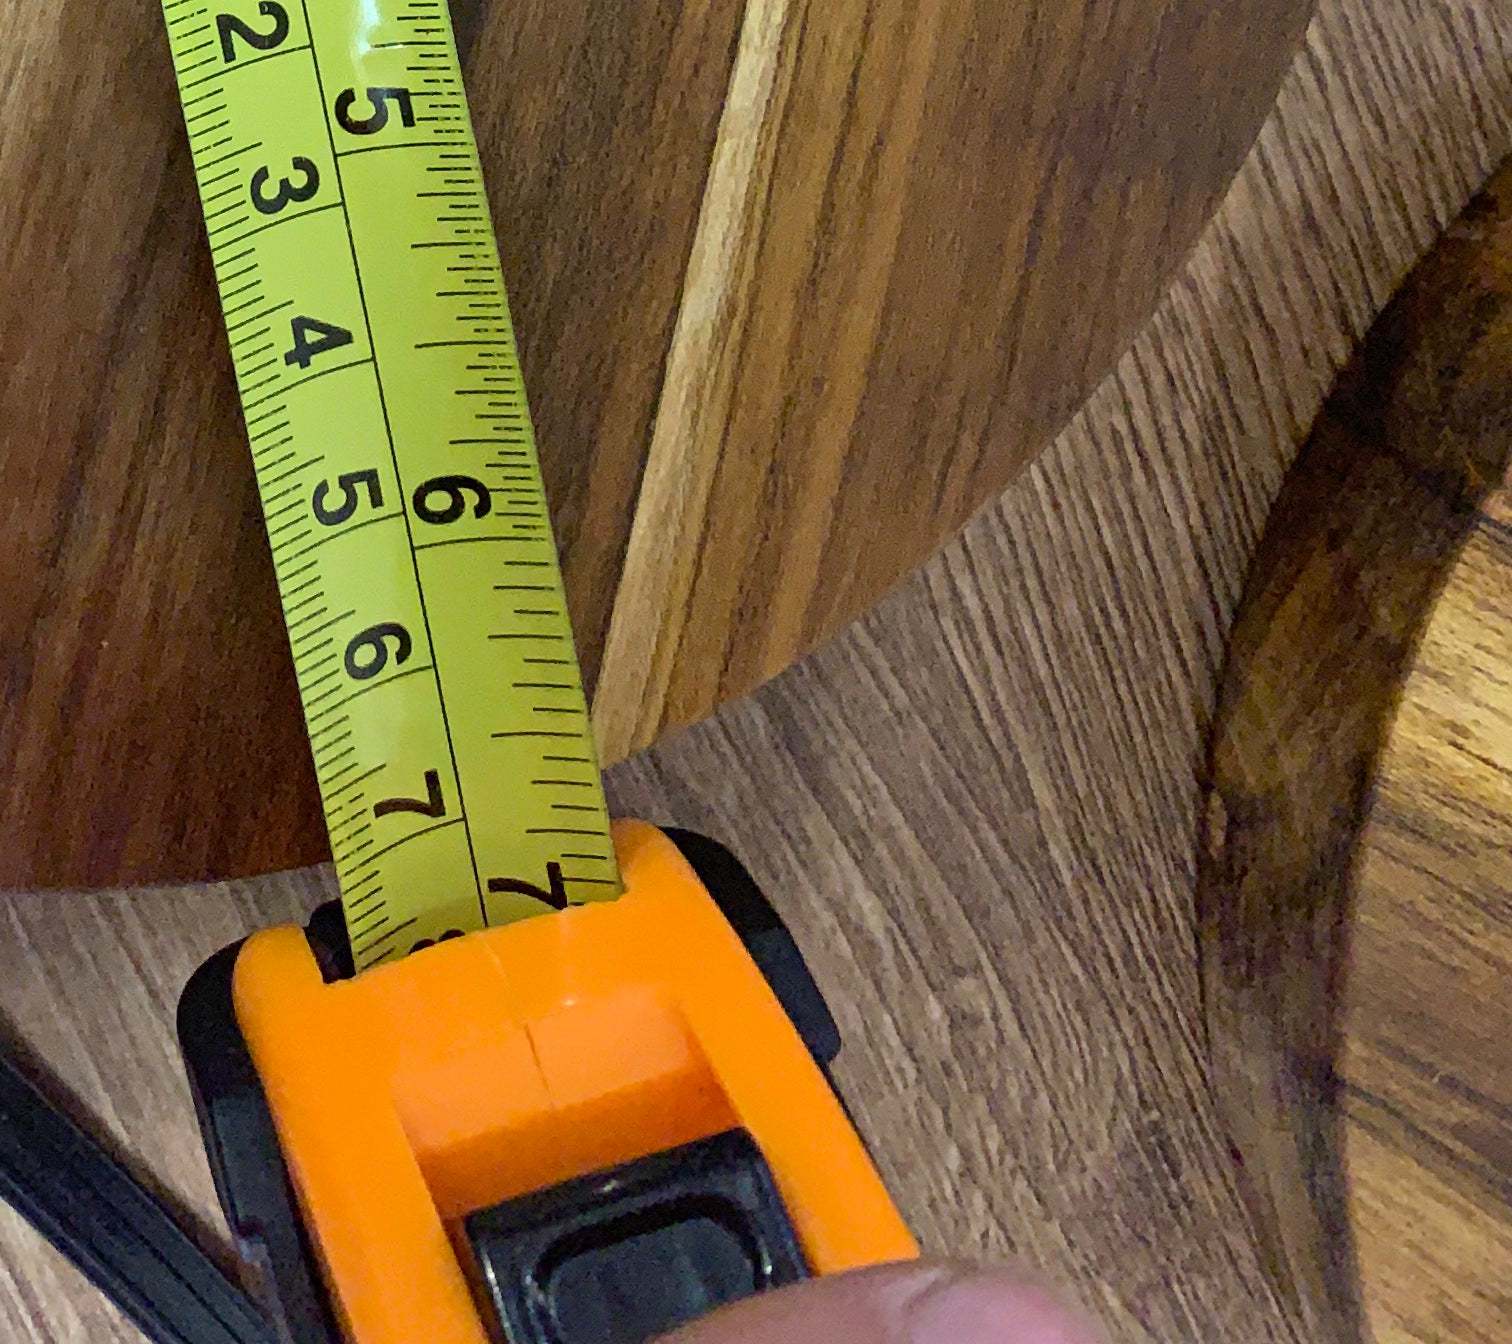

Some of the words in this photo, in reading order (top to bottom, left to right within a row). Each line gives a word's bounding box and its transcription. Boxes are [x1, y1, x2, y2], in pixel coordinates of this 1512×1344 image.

[216, 0, 289, 63] 2
[250, 156, 320, 215] 3
[284, 315, 353, 370] 4
[313, 468, 383, 526] 5
[334, 87, 416, 136] 5
[412, 474, 491, 526] 6
[487, 861, 568, 911] 7
[344, 622, 412, 681] 6
[373, 769, 446, 819] 7
